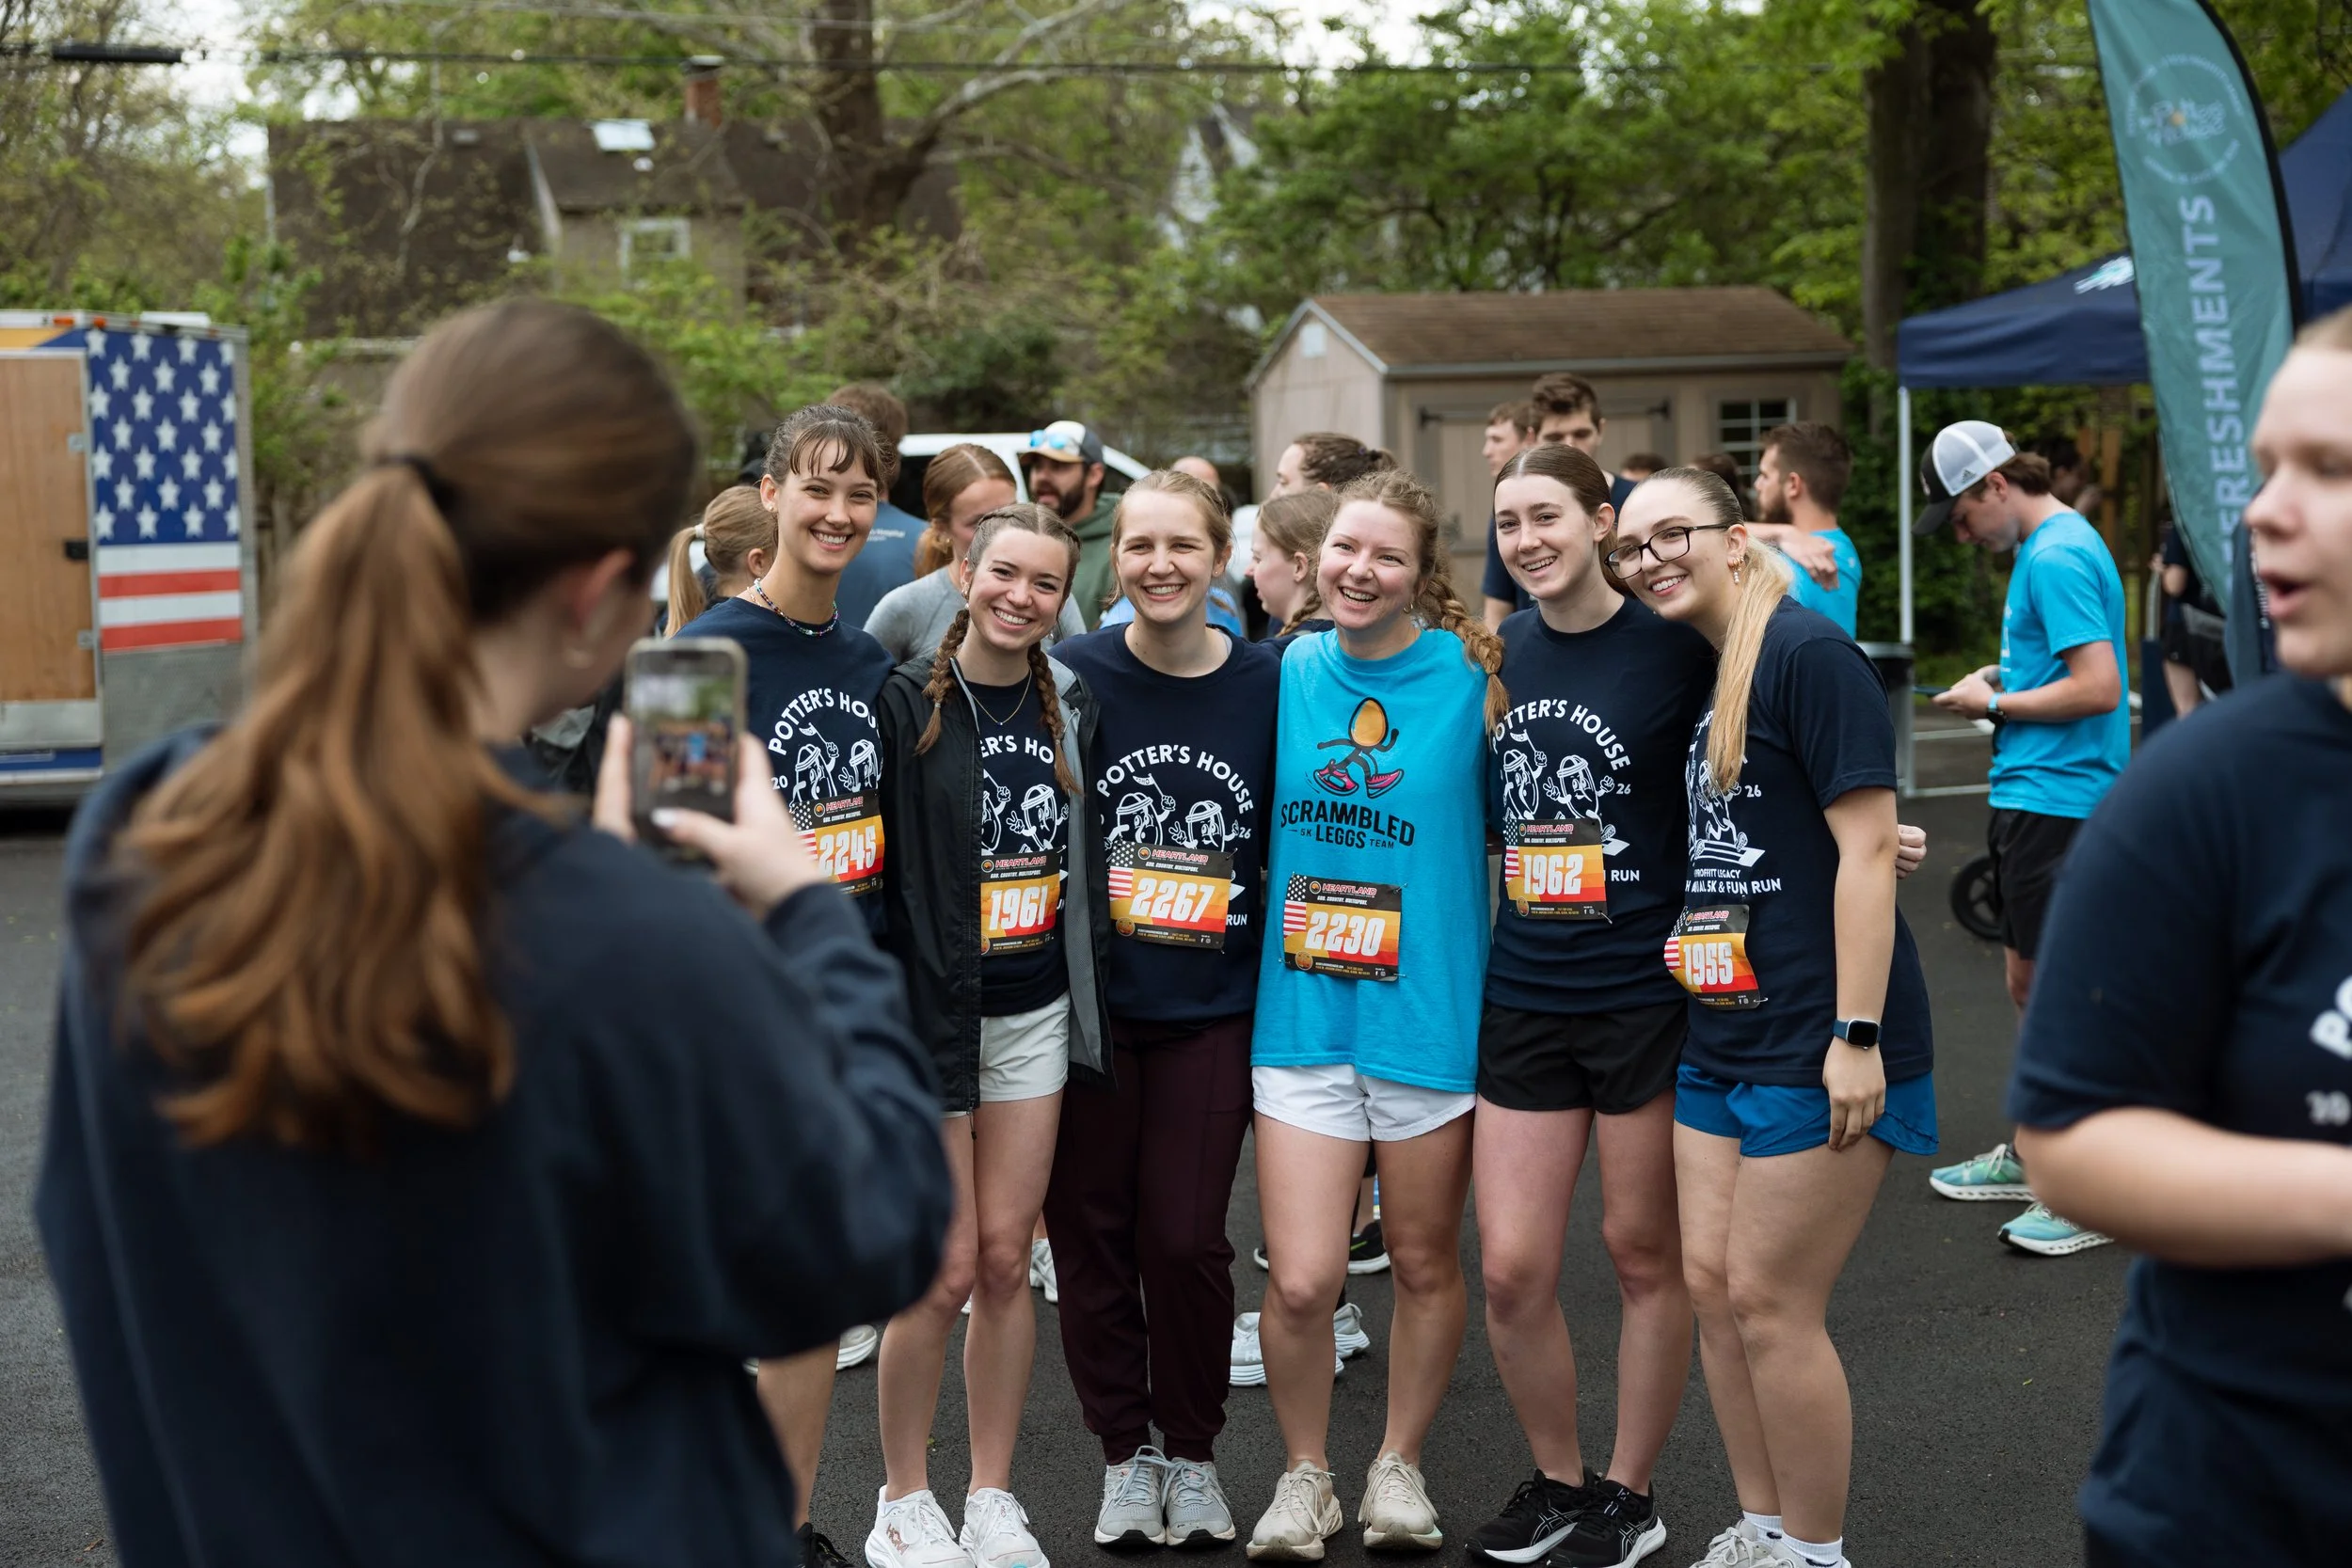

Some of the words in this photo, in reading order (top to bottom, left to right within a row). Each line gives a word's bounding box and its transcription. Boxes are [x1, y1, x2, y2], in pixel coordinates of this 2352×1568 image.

[2177, 194, 2251, 594] FRESHMENTS
[768, 688, 834, 756] POTTER'S
[839, 691, 877, 729] HOU
[1569, 705, 1631, 771] HOUSE
[1096, 744, 1191, 798] POTTER'S
[1196, 751, 1254, 815] HOUSE
[1616, 783, 1631, 795] 26
[1745, 784, 1762, 798] 26
[1238, 826, 1252, 839] 26
[1280, 800, 1416, 847] SCRAMBLED
[1300, 828, 1312, 837] 5K
[1315, 824, 1367, 849] LEGGS
[1370, 838, 1394, 849] TEAM
[1526, 824, 1574, 833] HEARTLAND
[818, 825, 877, 877] 2245
[1152, 849, 1209, 863] HEARTLAND
[1322, 883, 1377, 896] HEARTLAND
[1523, 853, 1583, 895] 1962
[1611, 869, 1640, 882] RUN
[1717, 869, 1740, 879] LEGACY
[1718, 880, 1725, 894] &
[1725, 880, 1749, 895] FUN
[1751, 878, 1782, 895] RUN
[989, 884, 1049, 931] 1961
[1129, 877, 1216, 923] 2267
[1226, 913, 1248, 926] RUN
[1305, 911, 1386, 957] 2230
[1683, 942, 1734, 986] 1955
